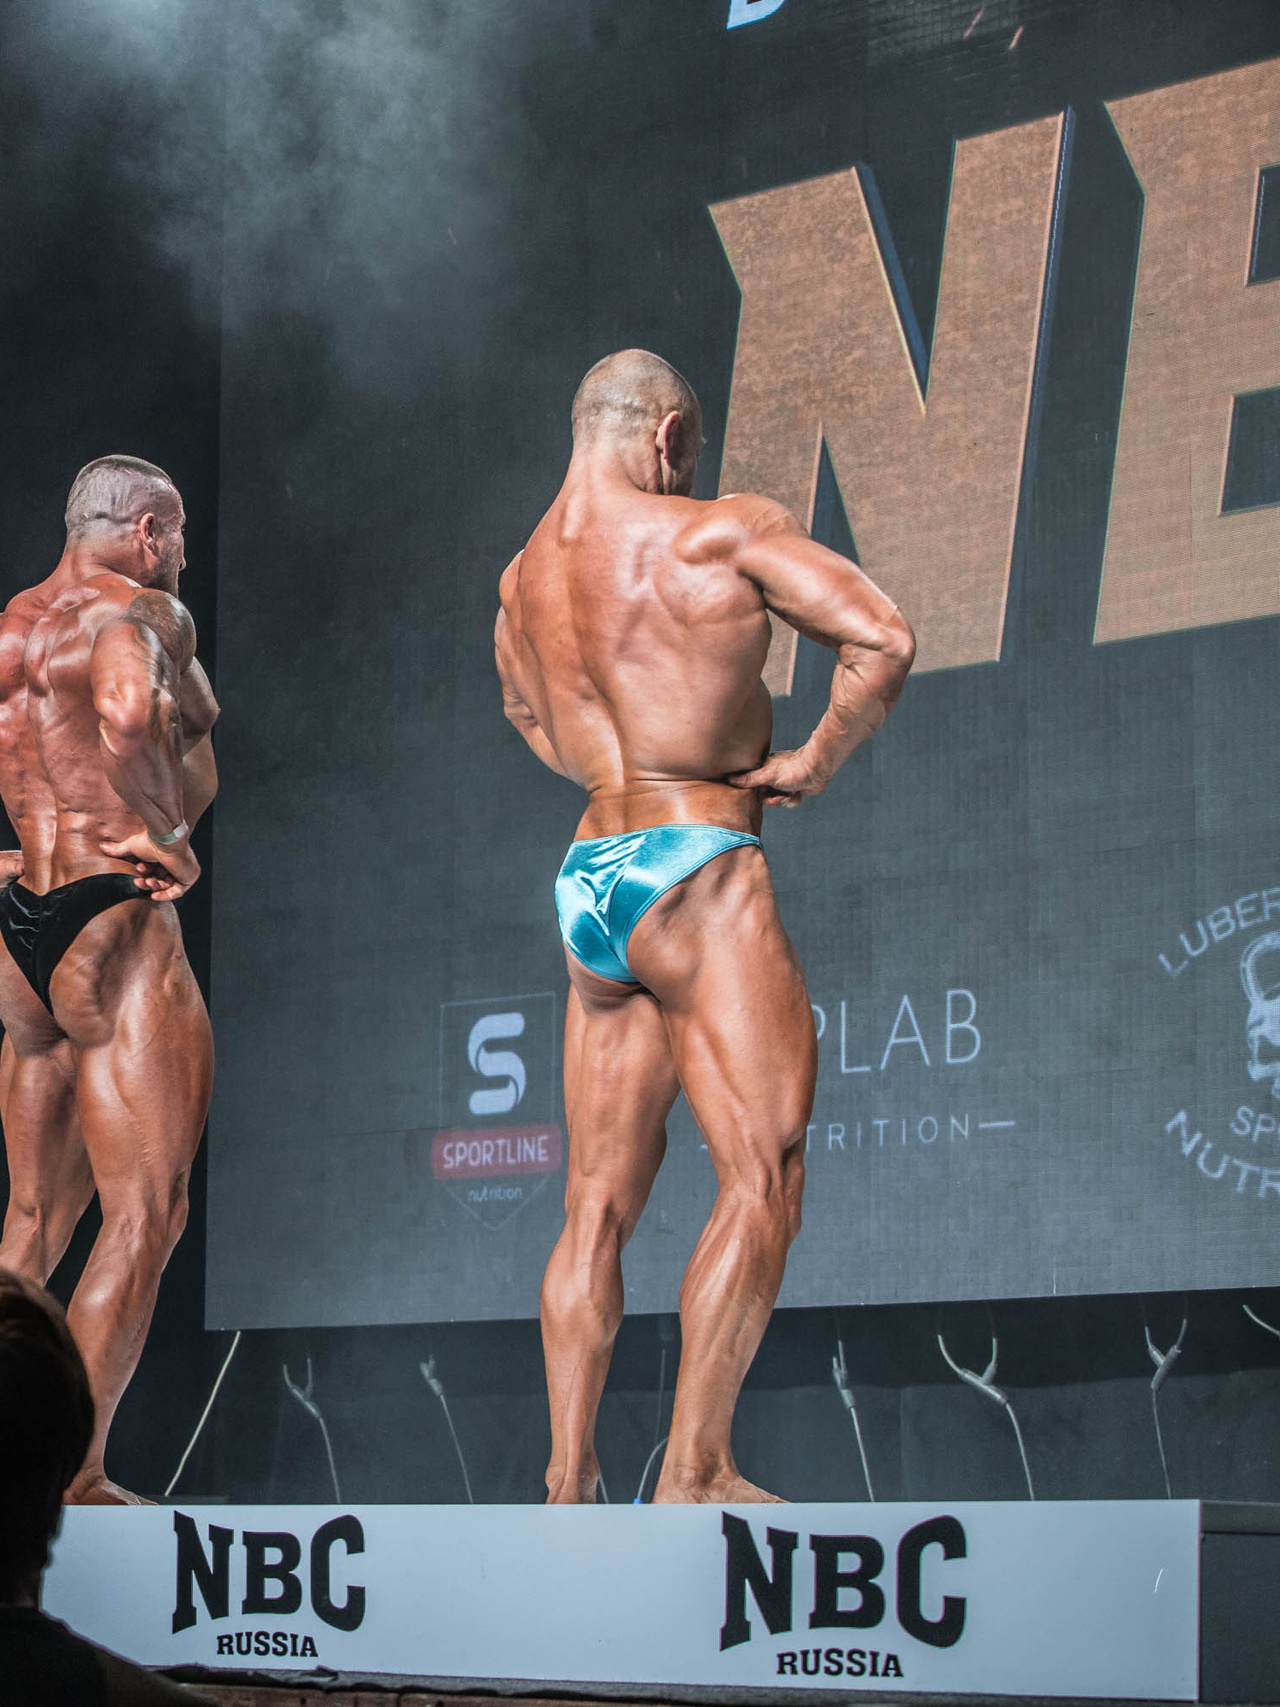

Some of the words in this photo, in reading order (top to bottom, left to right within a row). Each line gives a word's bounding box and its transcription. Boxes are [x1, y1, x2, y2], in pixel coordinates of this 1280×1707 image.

[1231, 1106, 1280, 1142] SP
[442, 1135, 549, 1169] SPORTLINE
[468, 1185, 523, 1202] nutrition
[172, 1510, 366, 1635] NBC
[719, 1511, 967, 1652] NBC
[216, 1631, 319, 1658] RUSSIA
[776, 1648, 904, 1678] RUSSIA
